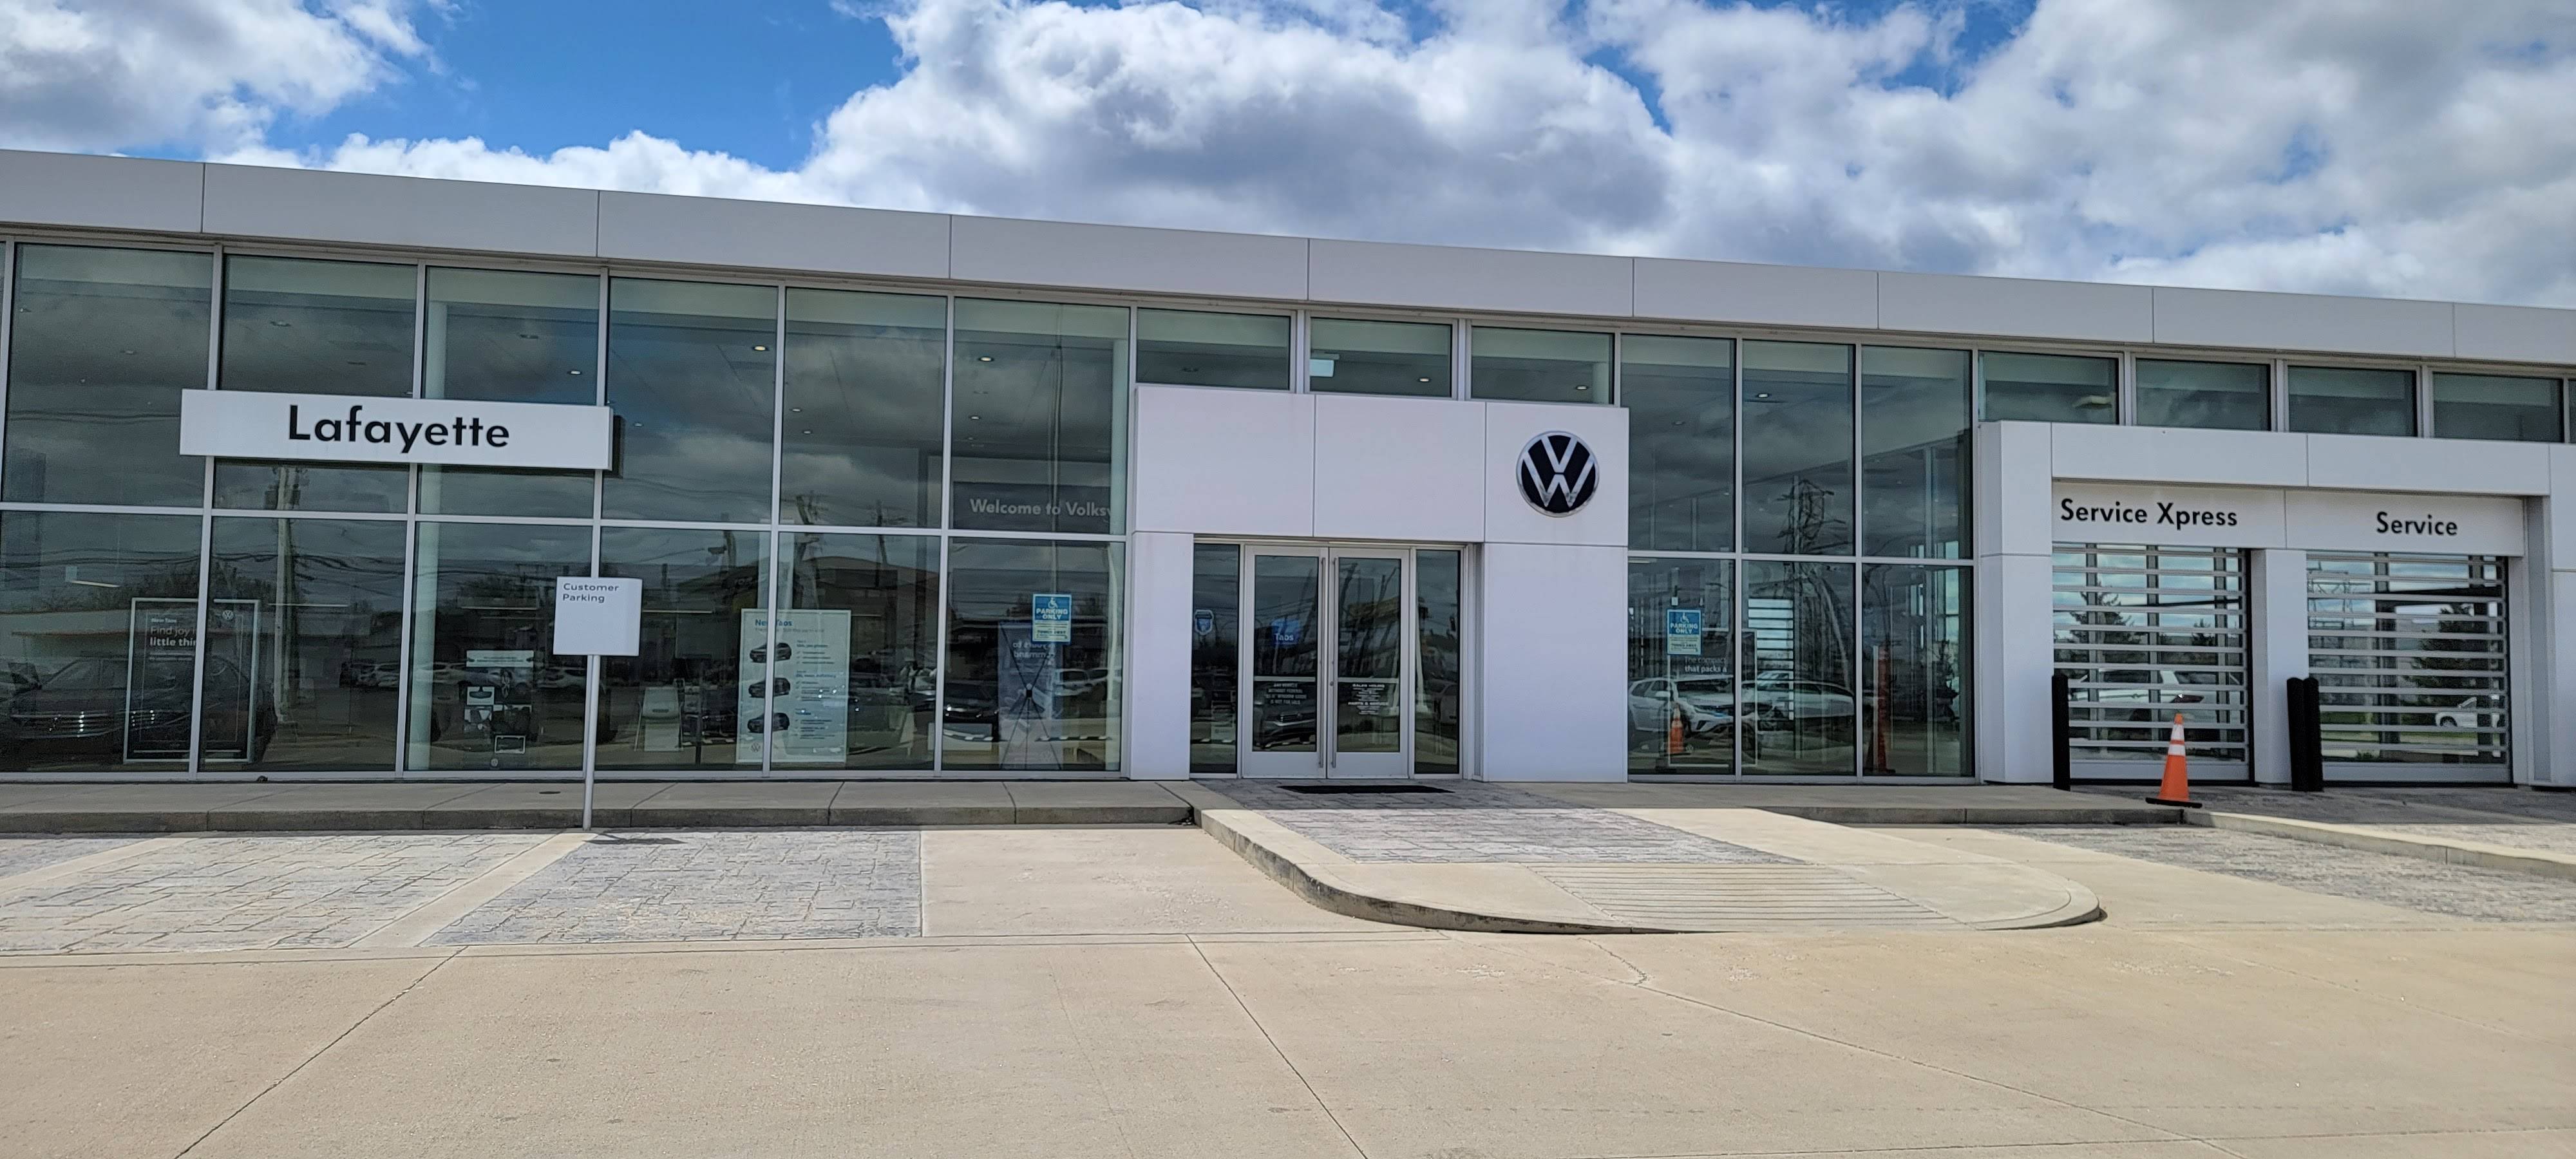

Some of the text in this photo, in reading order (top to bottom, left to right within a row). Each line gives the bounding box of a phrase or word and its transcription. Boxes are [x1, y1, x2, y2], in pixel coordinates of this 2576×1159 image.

[289, 404, 509, 454] Lafayette
[970, 498, 1041, 515] Welcome
[1046, 503, 1061, 515] to
[2061, 498, 2238, 531] Service Xpress
[2376, 511, 2458, 536] Service
[563, 583, 619, 591] Customer
[563, 593, 605, 603] Parking
[150, 626, 173, 635] Find
[175, 627, 189, 637] joy
[149, 636, 176, 646] little
